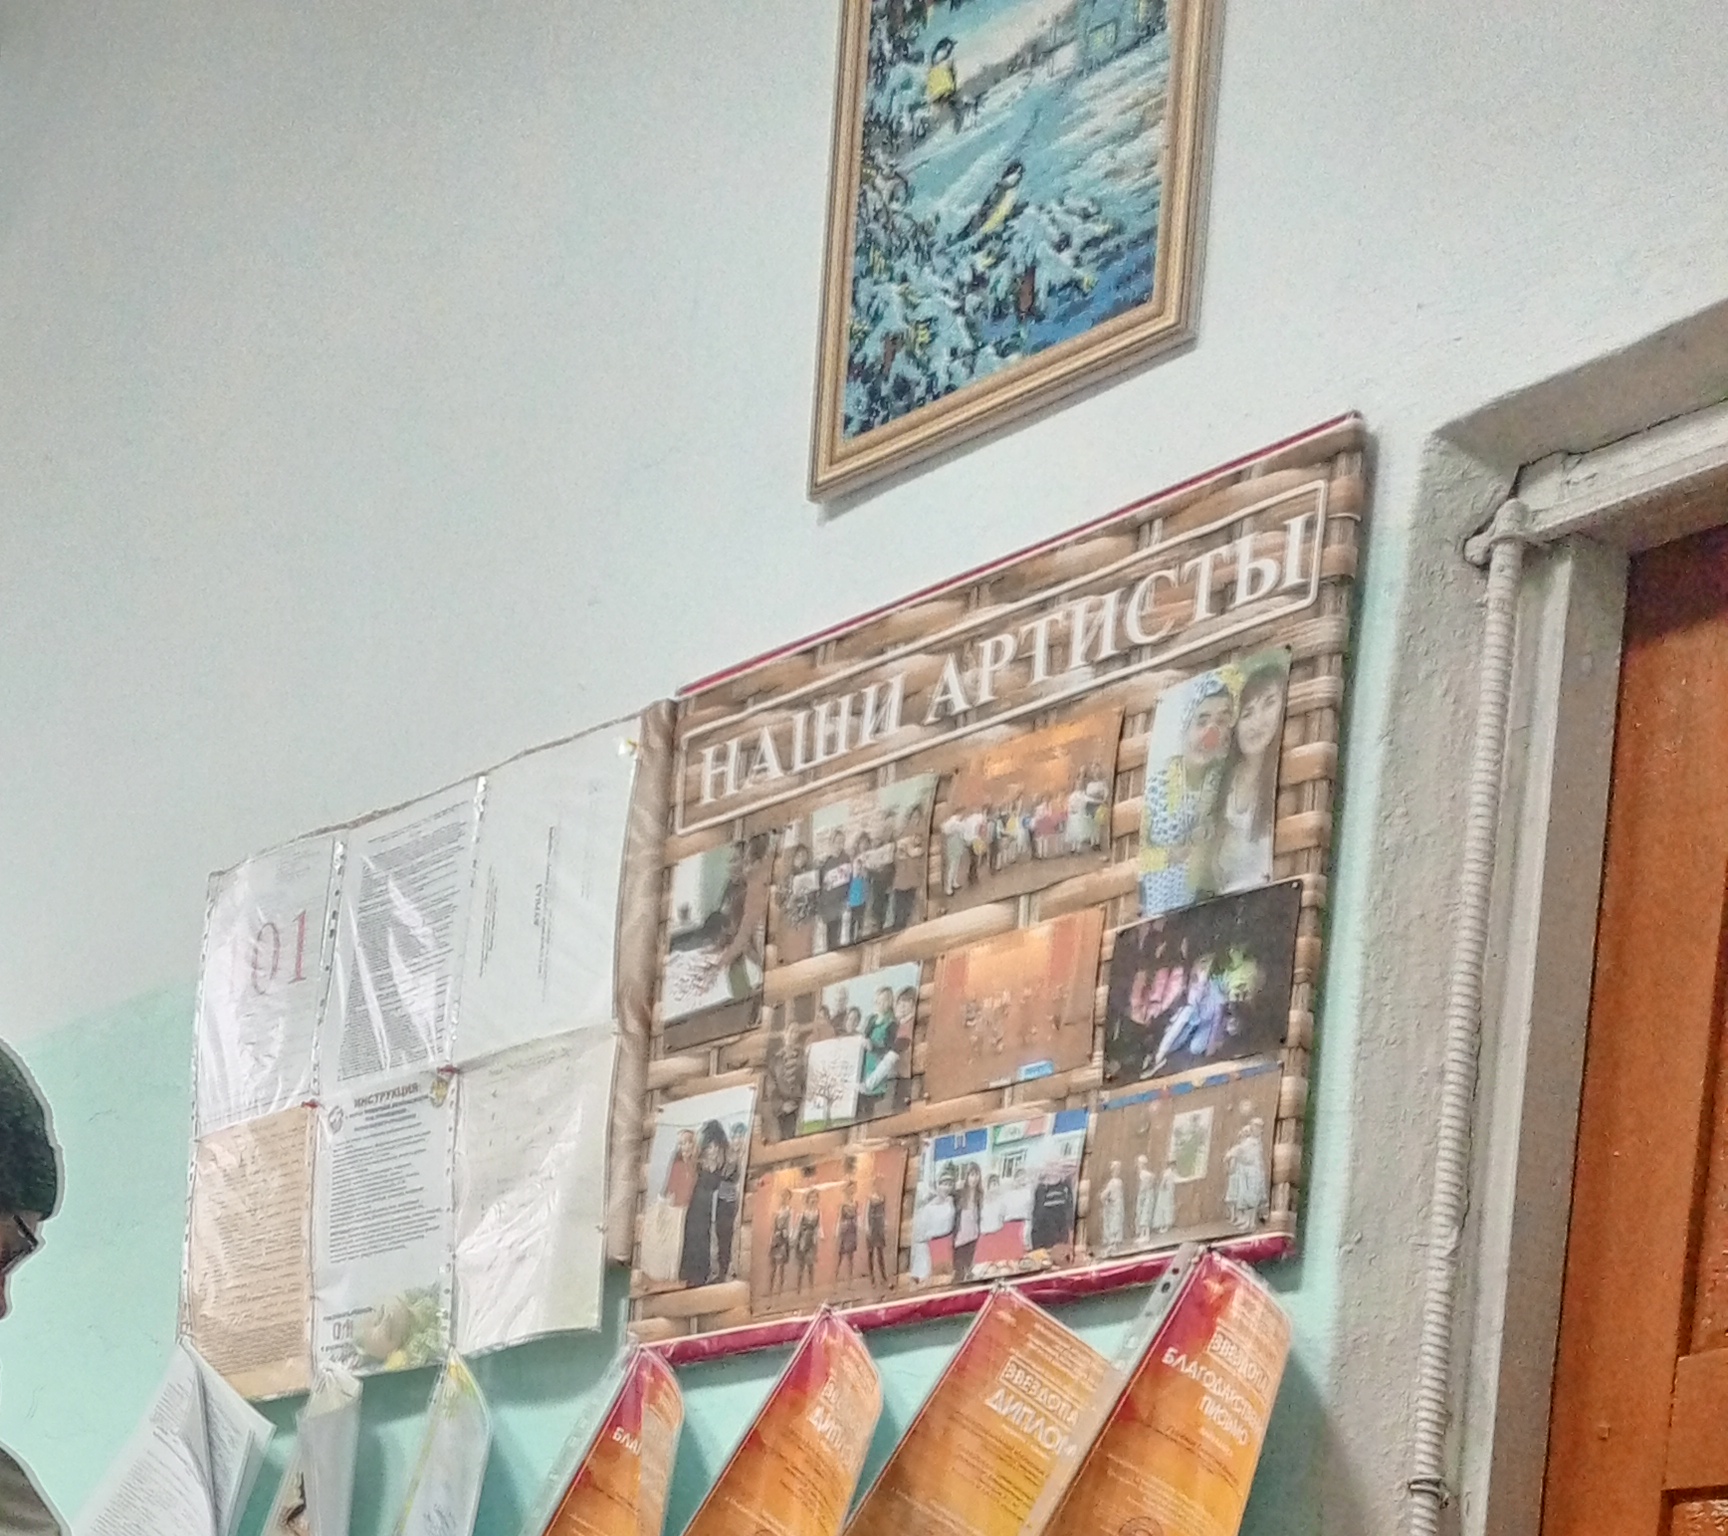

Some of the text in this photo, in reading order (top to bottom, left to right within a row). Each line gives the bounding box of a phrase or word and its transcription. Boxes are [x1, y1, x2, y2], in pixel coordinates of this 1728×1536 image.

[701, 516, 1315, 804] НАШИ АРТИСТЫ
[353, 1082, 419, 1108] ИНСТРУКЦИЯ
[984, 1388, 1079, 1456] ДИПЛОМ
[1003, 1362, 1080, 1426] ЗВЕЗДОПА
[1198, 1396, 1249, 1447] ПИСЬМО
